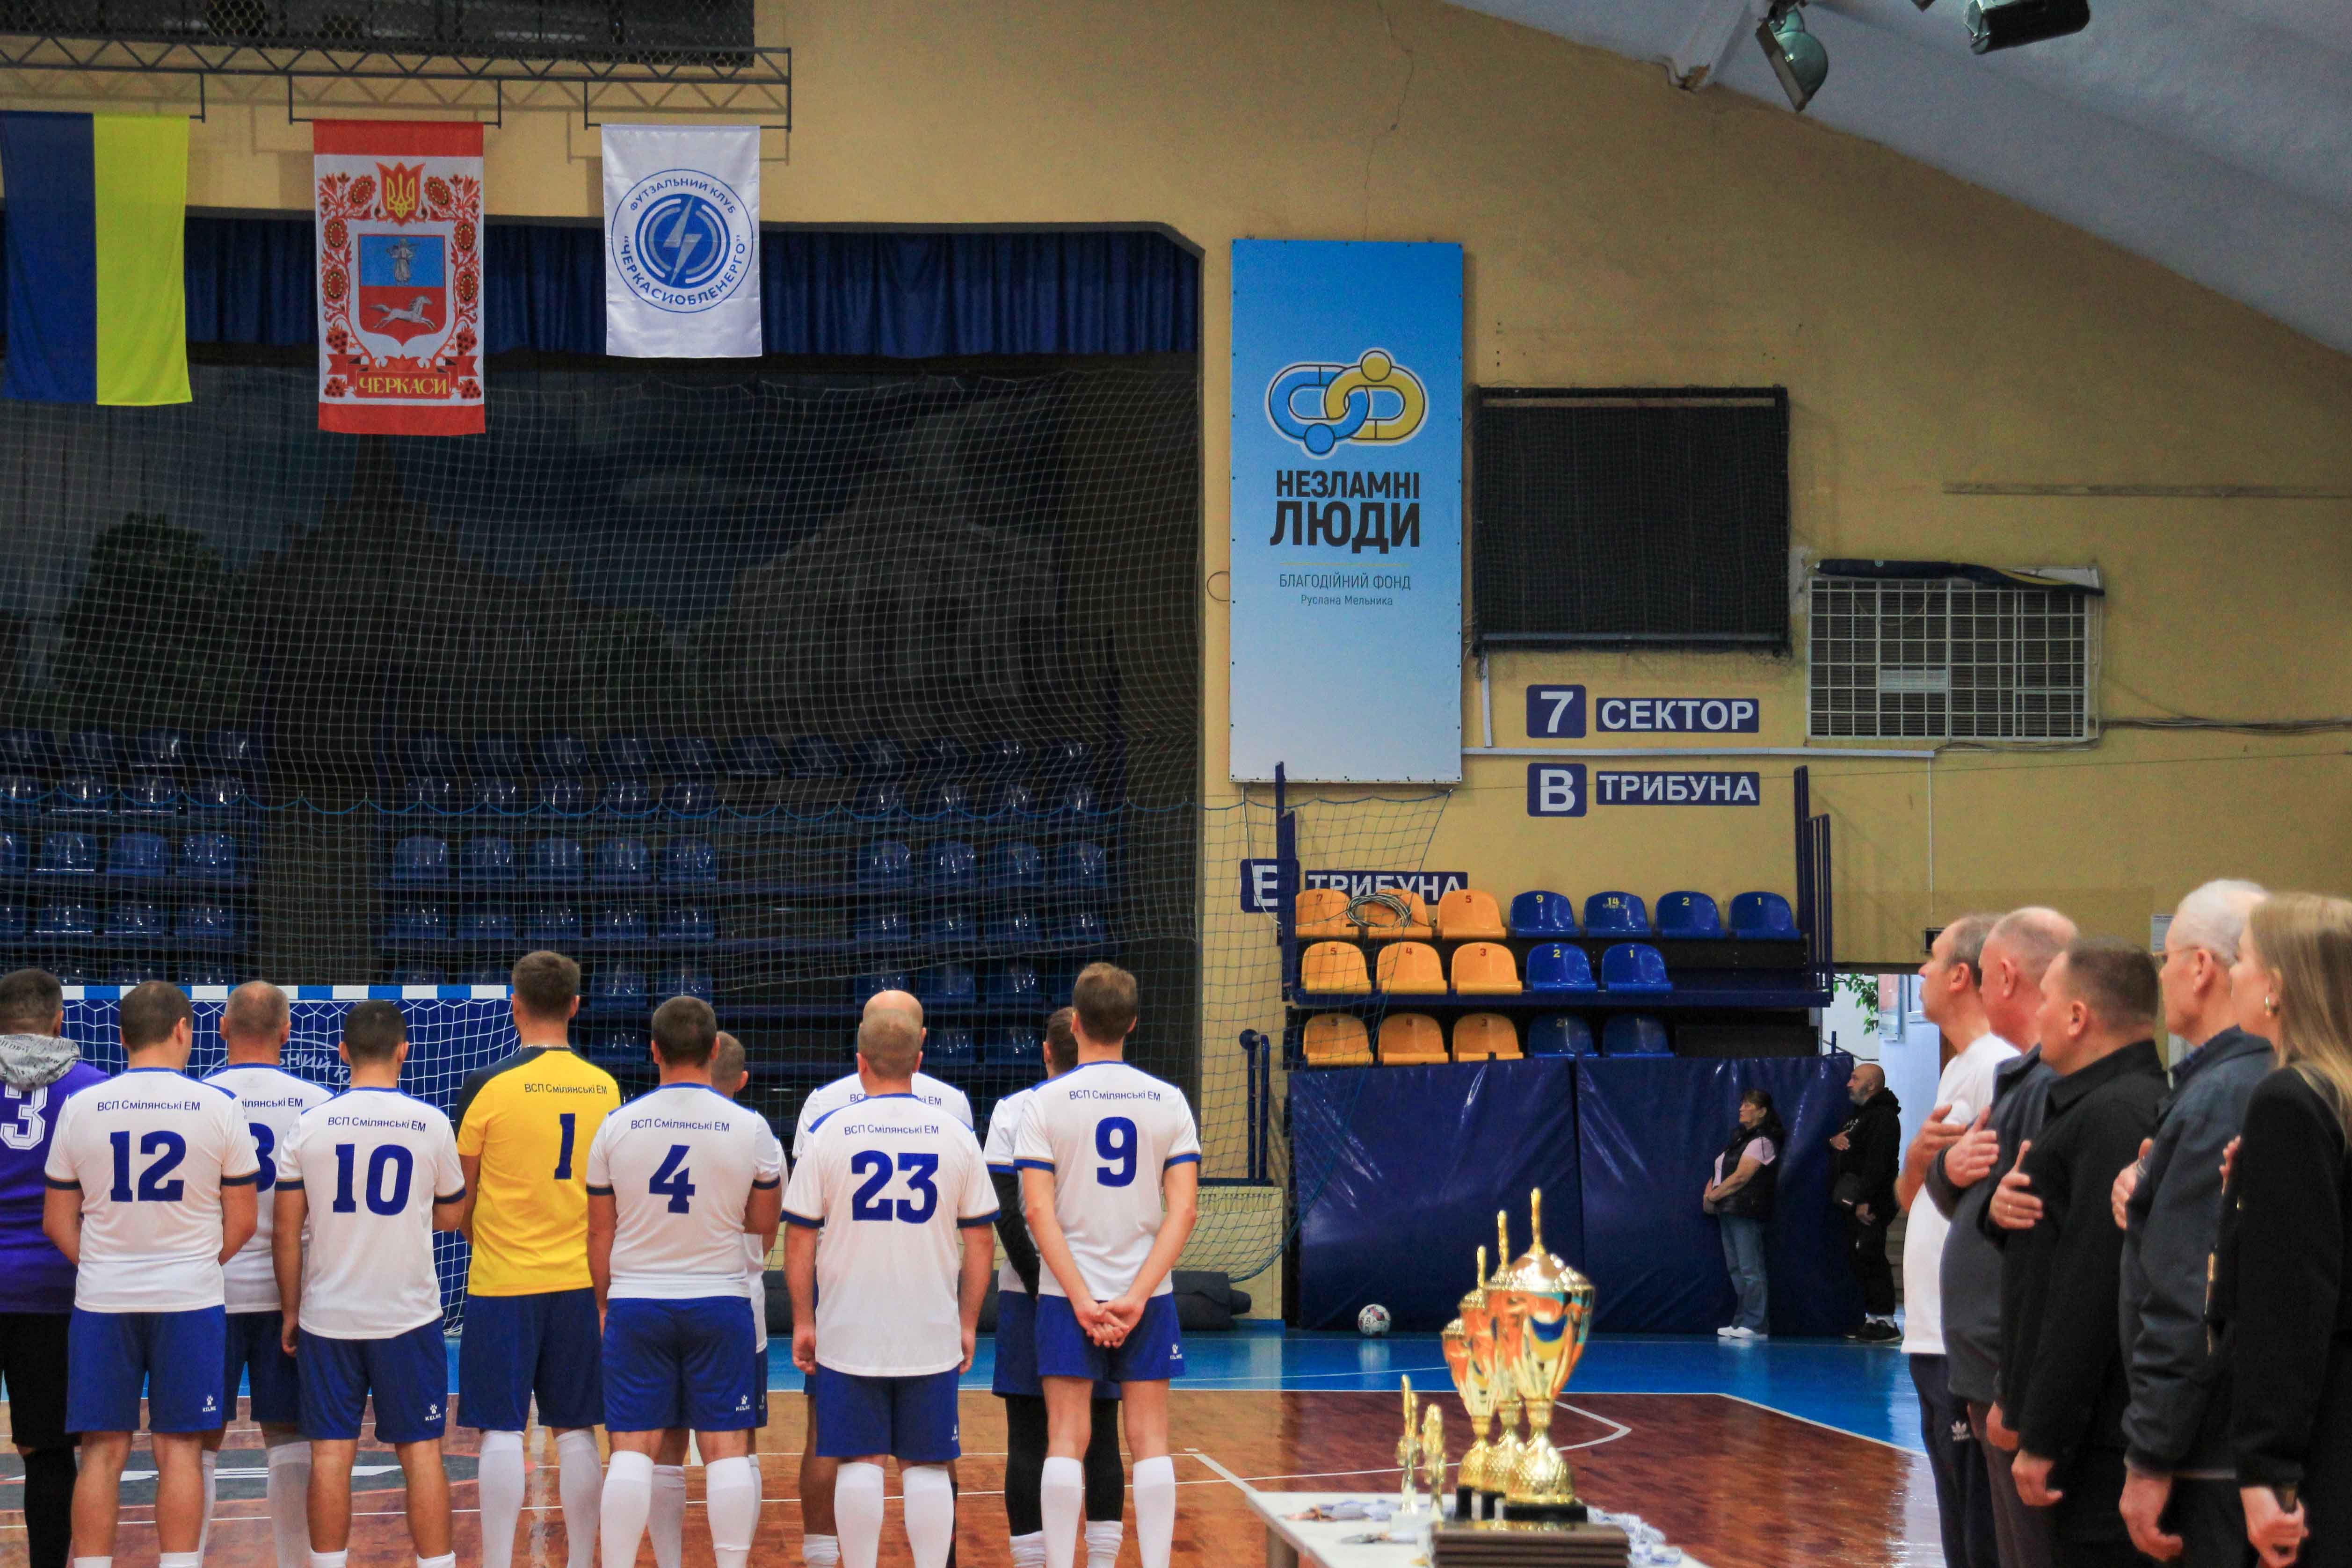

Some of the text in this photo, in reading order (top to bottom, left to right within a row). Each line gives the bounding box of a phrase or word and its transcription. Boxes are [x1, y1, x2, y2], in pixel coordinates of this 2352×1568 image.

[630, 178, 736, 214] ФУТЗАЛЬНИЙ КЛУБ
[359, 376, 448, 395] ЧЕРКАСИ
[1276, 470, 1420, 499] НЕЗЛАМНІ
[1270, 501, 1420, 554] ЛЮДИ
[1279, 572, 1411, 591] БЛАГОДІЙНИЙ ФОНД
[1301, 595, 1393, 606] Руслана Мельника
[1541, 691, 1754, 733] 7 СЕКТОР
[1540, 769, 1757, 812] В ТРИБУНА
[1536, 894, 1544, 903] 9
[1682, 897, 1690, 906] 2
[1757, 897, 1762, 906] 1
[1480, 948, 1486, 956] 3
[1553, 949, 1561, 958] 2
[1629, 949, 1634, 958] 1
[1481, 1018, 1487, 1027] 3
[1556, 1018, 1564, 1027] 2
[525, 1083, 608, 1095] ВСП Смілянські ЕМ
[1069, 1089, 1161, 1102] ВСП Смілянські ЕМ
[97, 1100, 200, 1111] ВСП Смілянські ЕМ
[242, 1097, 303, 1108] ілянські ЕМ
[929, 1096, 942, 1106] ЕМ
[328, 1117, 426, 1132] ВСП Смілянські ЕМ
[631, 1118, 730, 1132] ВСП Смілянські ЕМ
[844, 1124, 939, 1135] ВСП Смілянські ЕМ
[554, 1113, 575, 1180] 1
[1095, 1117, 1138, 1188] 9
[110, 1130, 187, 1202] 12
[333, 1144, 414, 1216] 10
[649, 1145, 696, 1214] 4
[851, 1150, 939, 1225] 23
